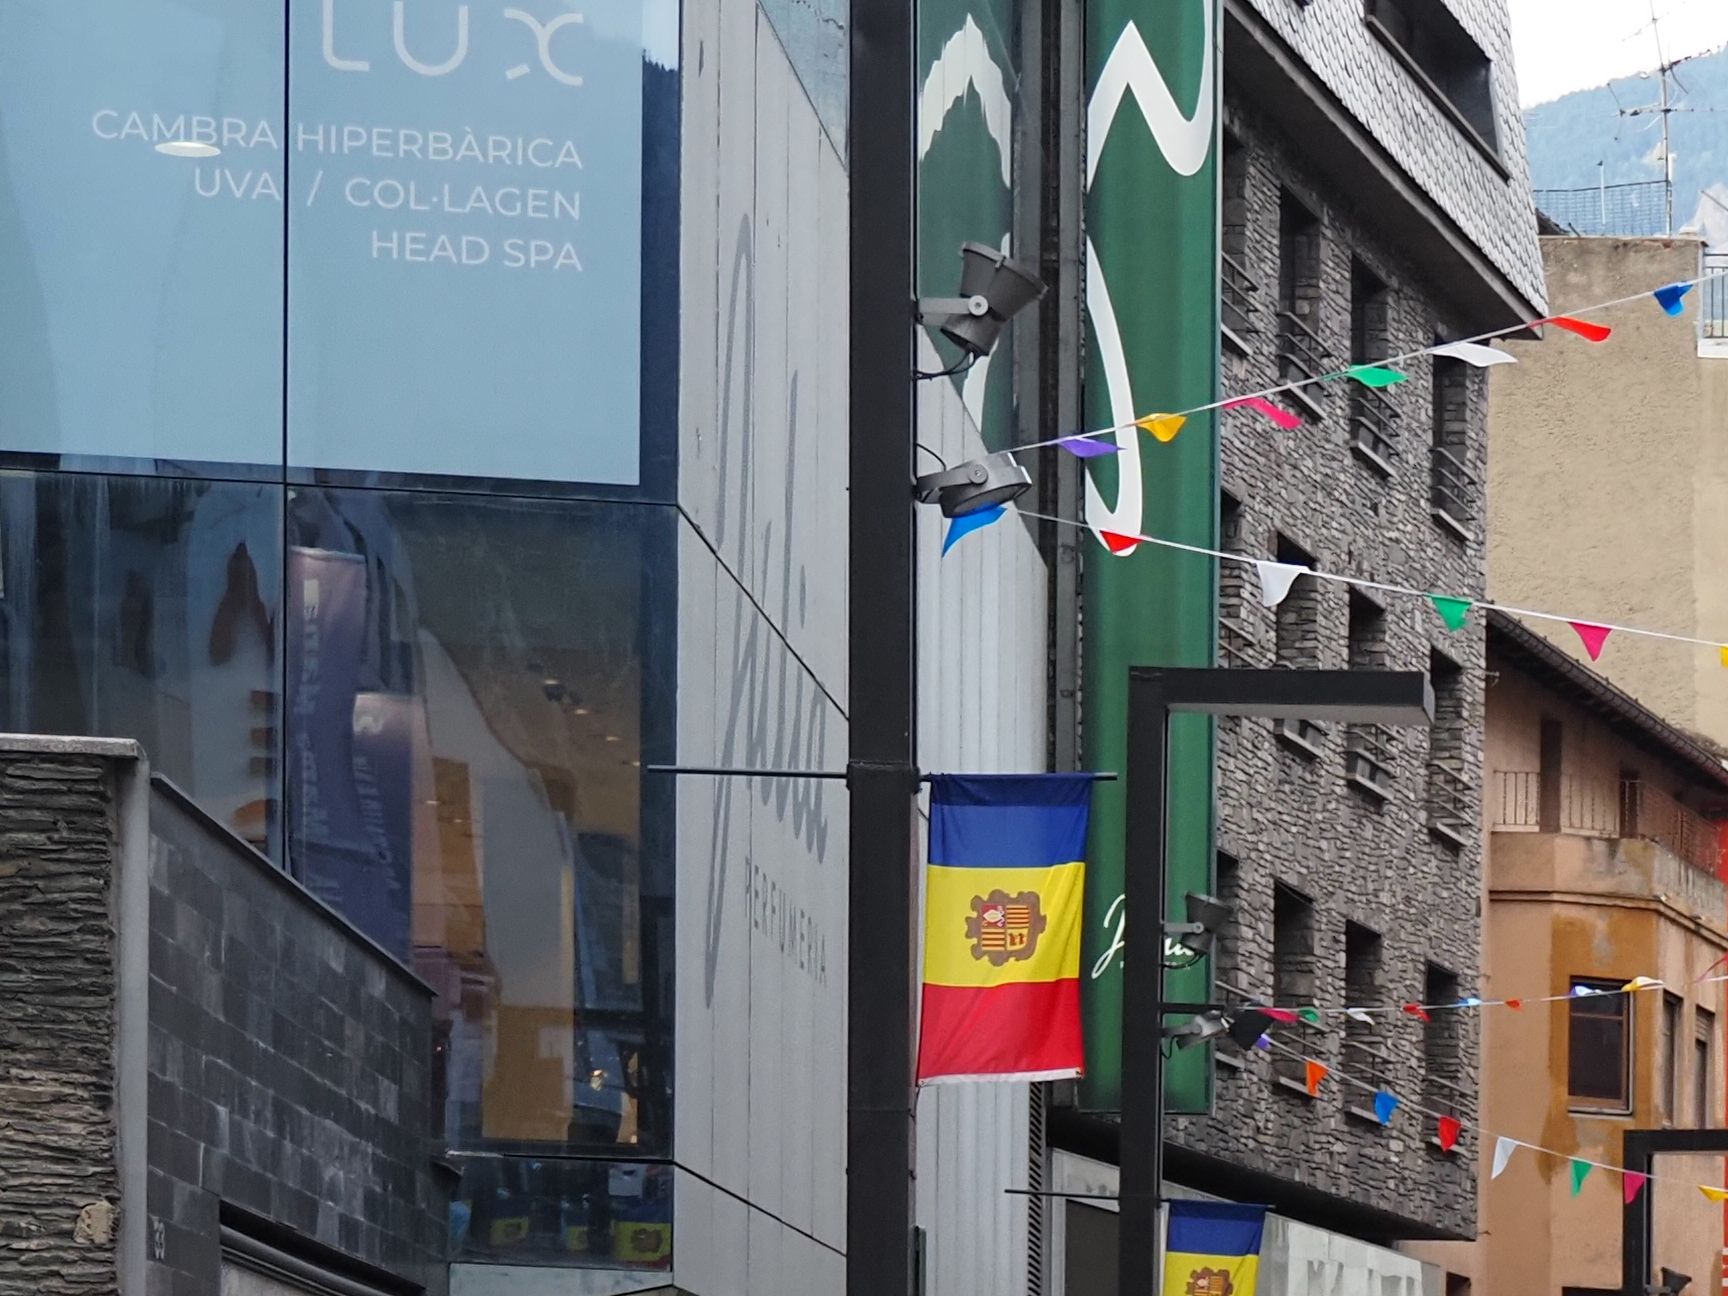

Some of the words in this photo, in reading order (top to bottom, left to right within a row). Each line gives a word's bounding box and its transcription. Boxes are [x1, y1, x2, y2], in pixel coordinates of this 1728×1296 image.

[91, 109, 277, 150] CAMBRA
[297, 121, 583, 171] HIPERBÀRICA
[193, 169, 281, 202] UVA
[370, 230, 491, 266] HEAD
[502, 237, 583, 272] SPA
[744, 855, 828, 988] PERFUMERIA
